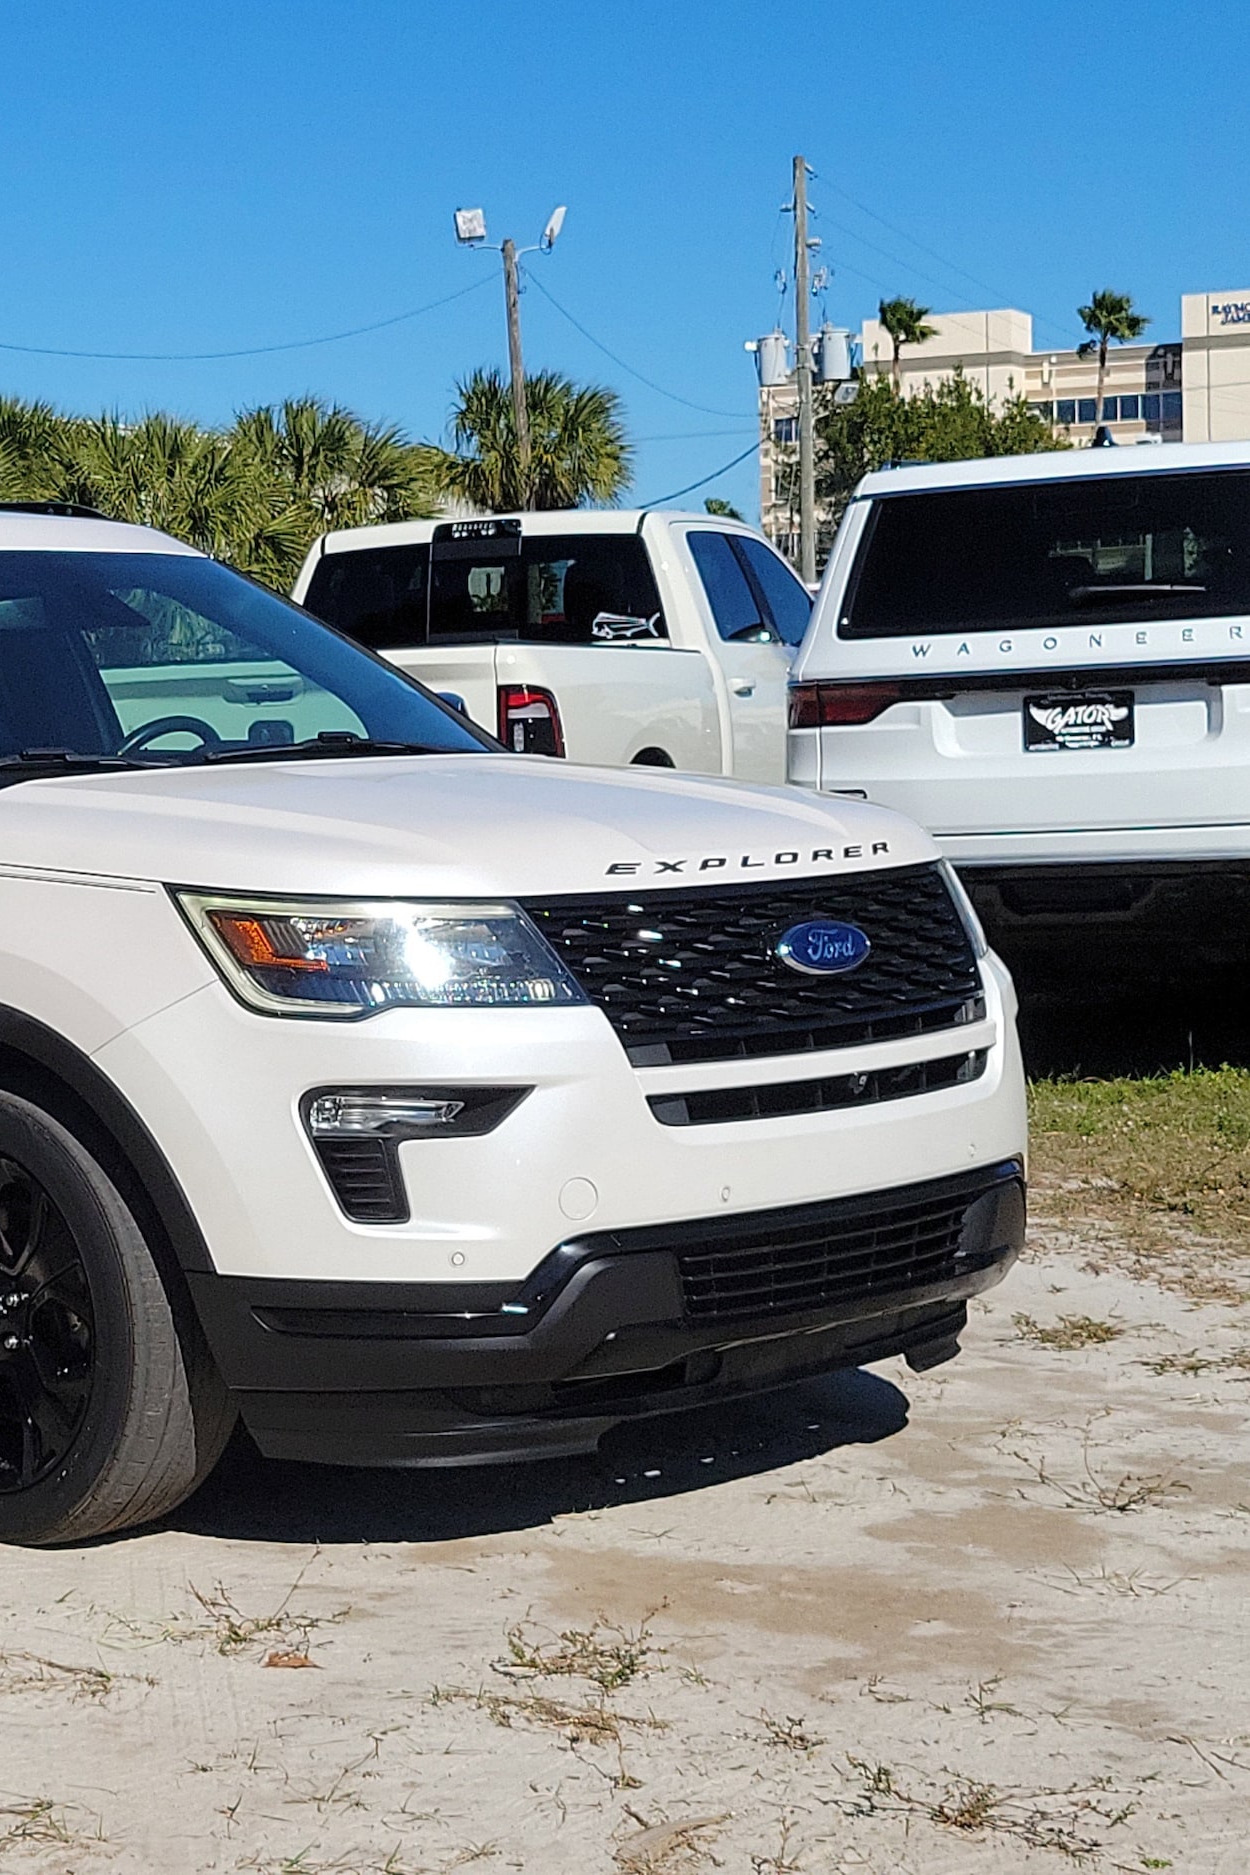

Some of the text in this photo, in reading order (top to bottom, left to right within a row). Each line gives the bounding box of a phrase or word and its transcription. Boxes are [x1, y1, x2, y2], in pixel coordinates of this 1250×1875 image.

[912, 625, 1243, 657] WAGONEER
[1046, 703, 1114, 735] GATOR
[605, 841, 890, 875] EXPLORER
[806, 928, 855, 961] Ford
